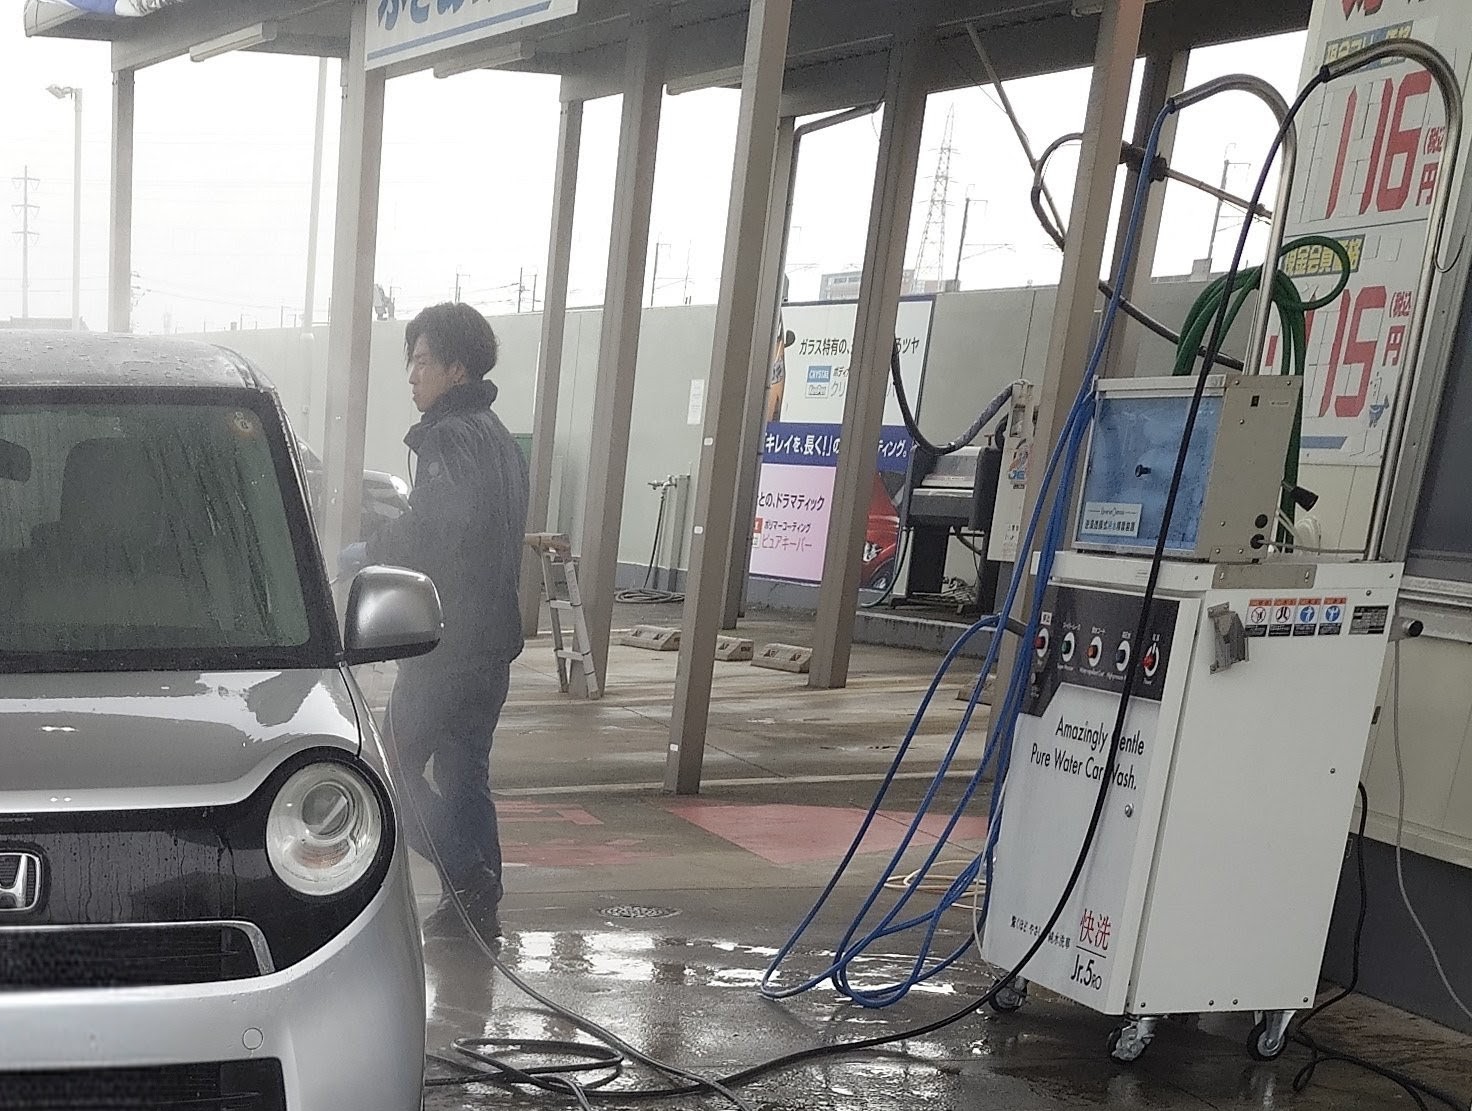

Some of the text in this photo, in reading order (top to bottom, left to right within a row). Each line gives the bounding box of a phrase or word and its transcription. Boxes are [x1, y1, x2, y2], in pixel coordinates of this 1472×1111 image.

[1324, 69, 1432, 219] 116
[798, 337, 851, 355] ガラス特有の、
[1381, 325, 1406, 367] 円
[757, 491, 825, 512] との、ドラマティック
[1055, 714, 1145, 756] Amazingly entle
[1030, 742, 1051, 767] Pure
[1054, 747, 1084, 776] Water
[1085, 756, 1105, 781] Car
[1079, 907, 1111, 951] 快洗
